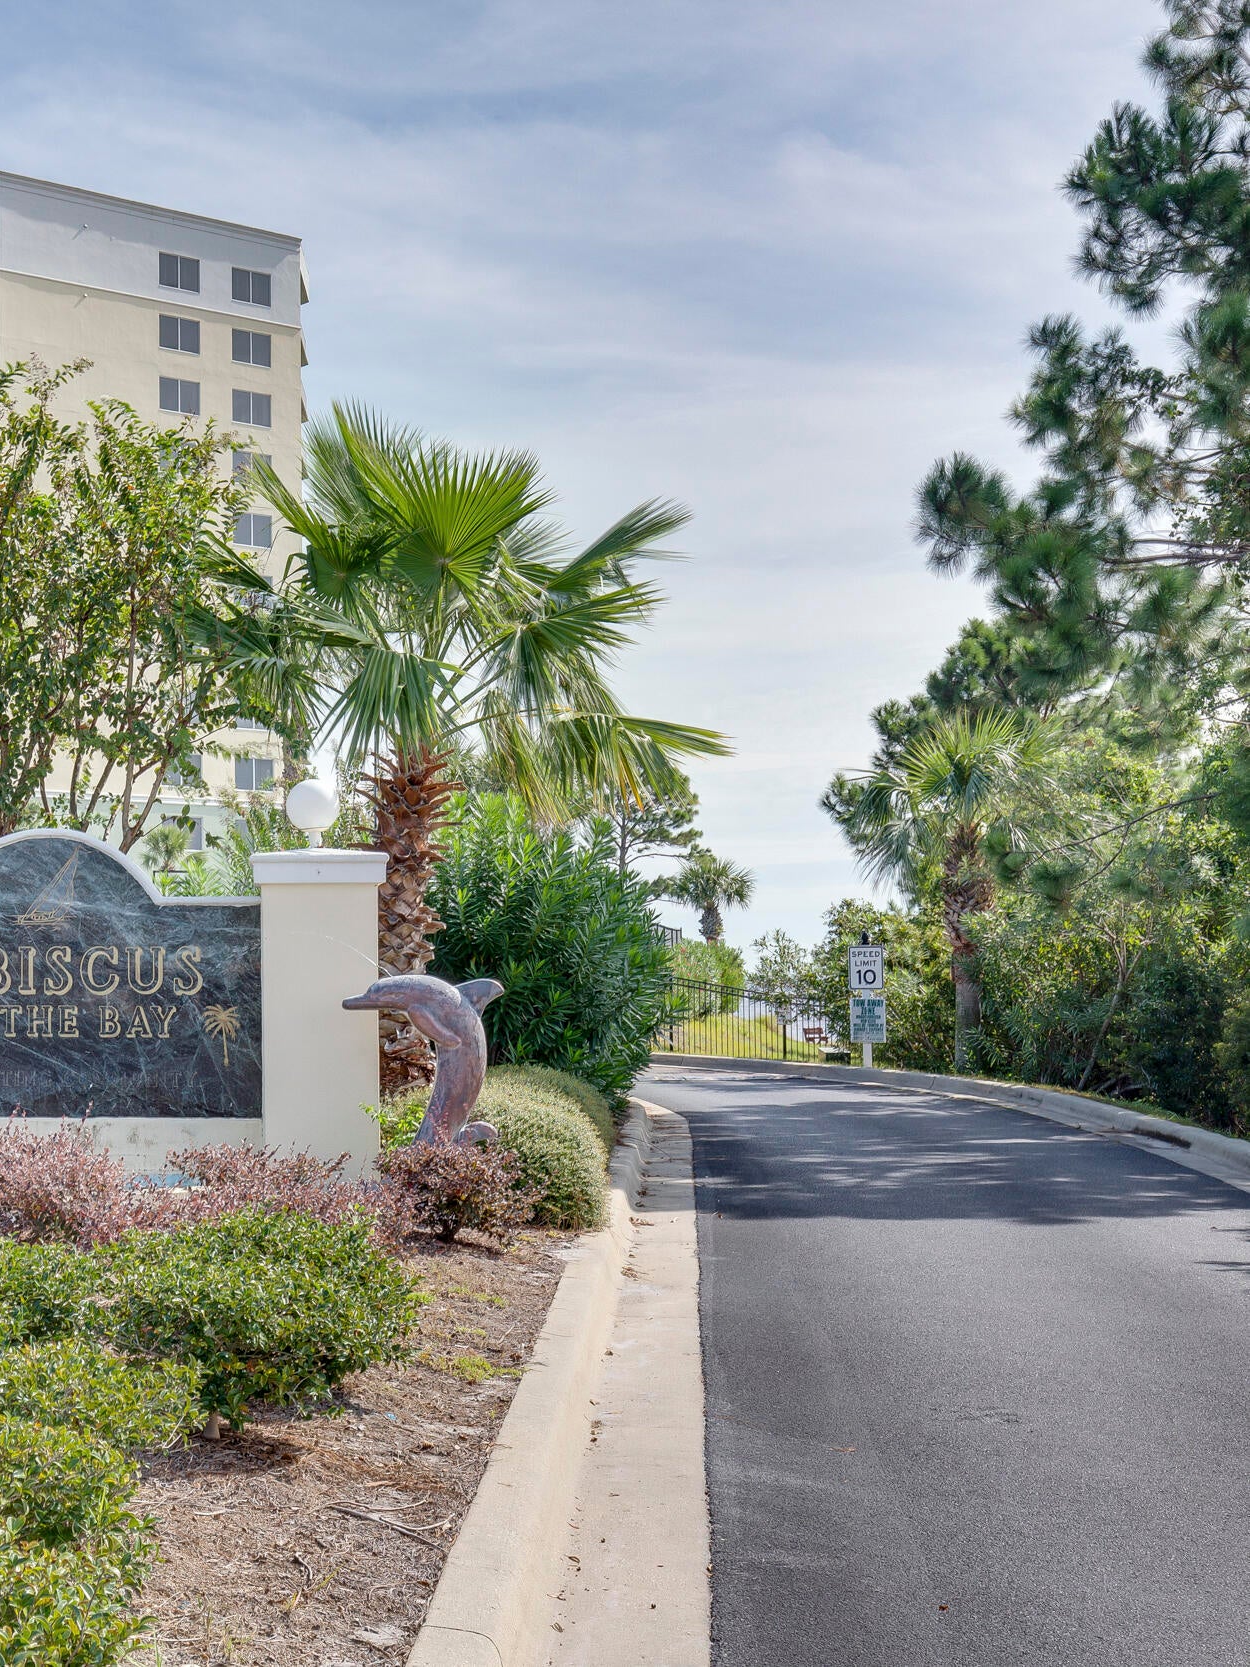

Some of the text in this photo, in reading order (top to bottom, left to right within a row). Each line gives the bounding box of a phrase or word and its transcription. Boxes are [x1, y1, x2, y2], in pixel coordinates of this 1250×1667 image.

[851, 950, 880, 958] SPEED
[856, 969, 876, 985] 10
[867, 999, 883, 1007] AWAY
[99, 1004, 177, 1038] BAY
